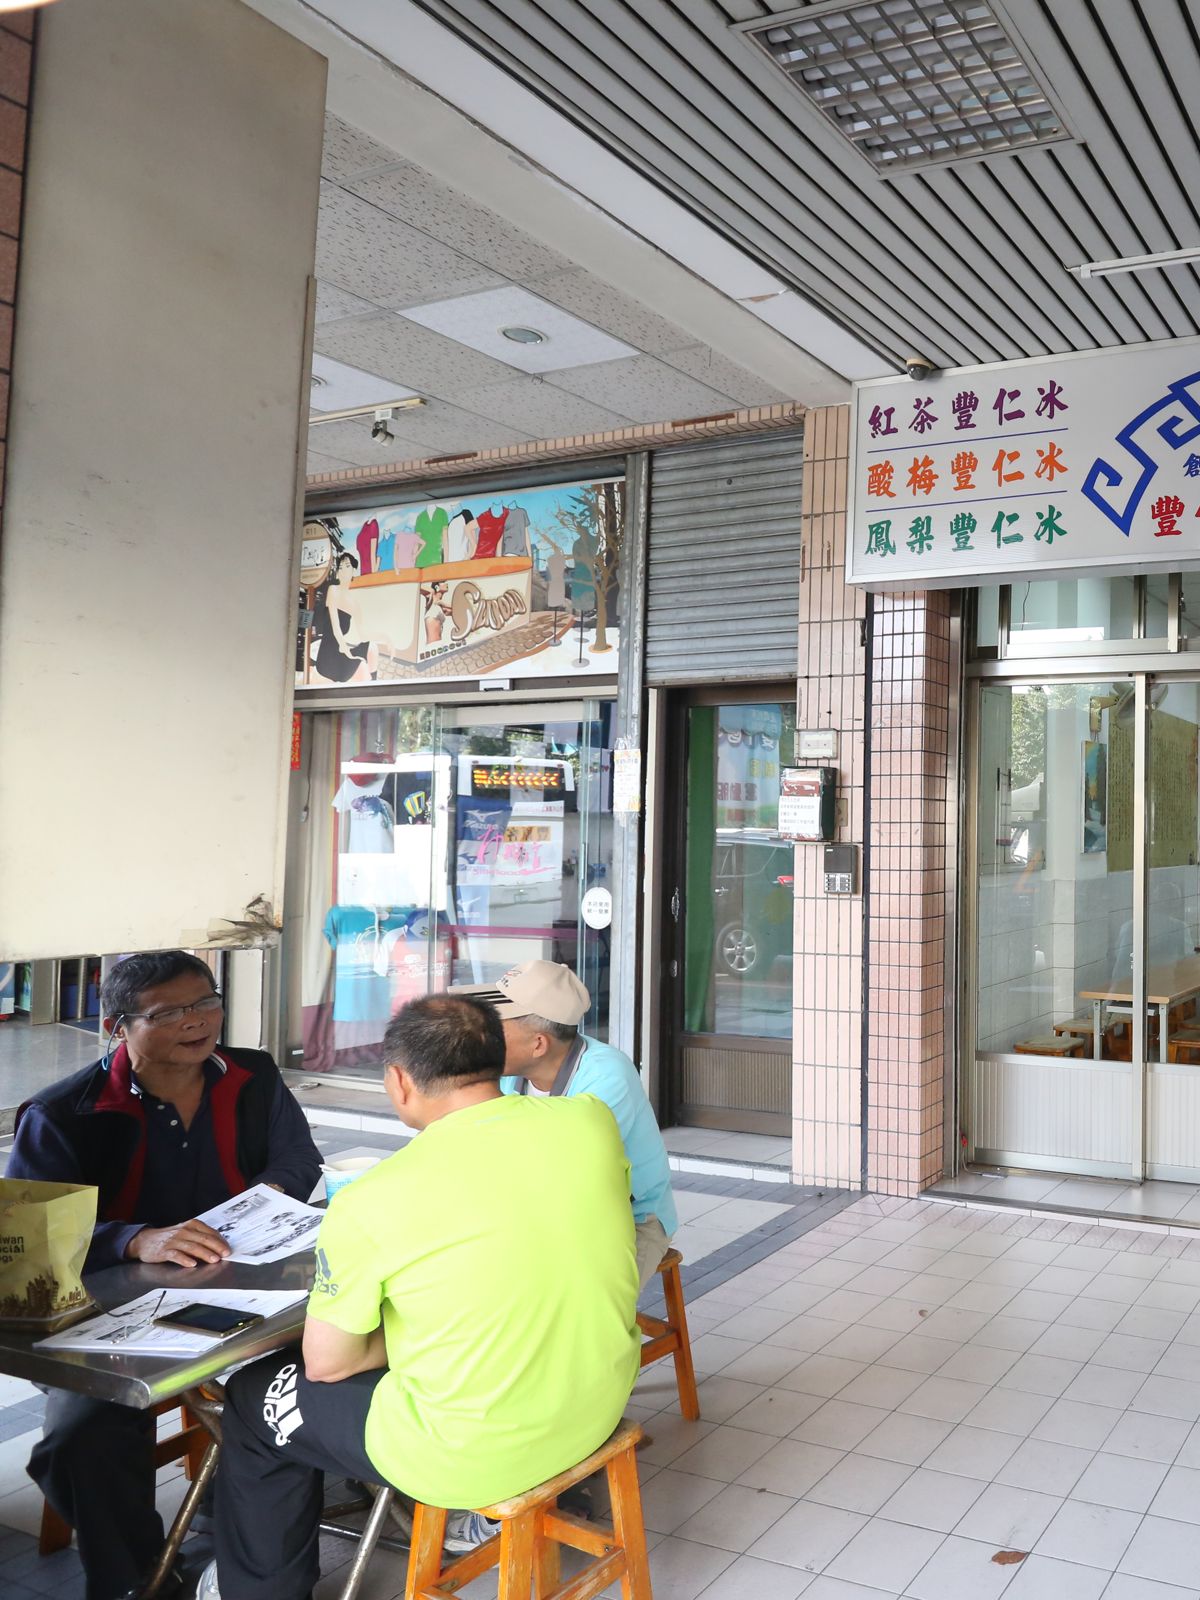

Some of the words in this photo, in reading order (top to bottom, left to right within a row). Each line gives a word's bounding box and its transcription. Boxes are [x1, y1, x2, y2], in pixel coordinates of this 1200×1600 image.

[868, 380, 1068, 437] 紅茶豐仁冰
[867, 442, 1068, 499] 酸梅豐仁冰
[865, 505, 1067, 557] 鳳梨豐仁冰
[0, 1234, 24, 1245] wan
[0, 1244, 25, 1254] cial
